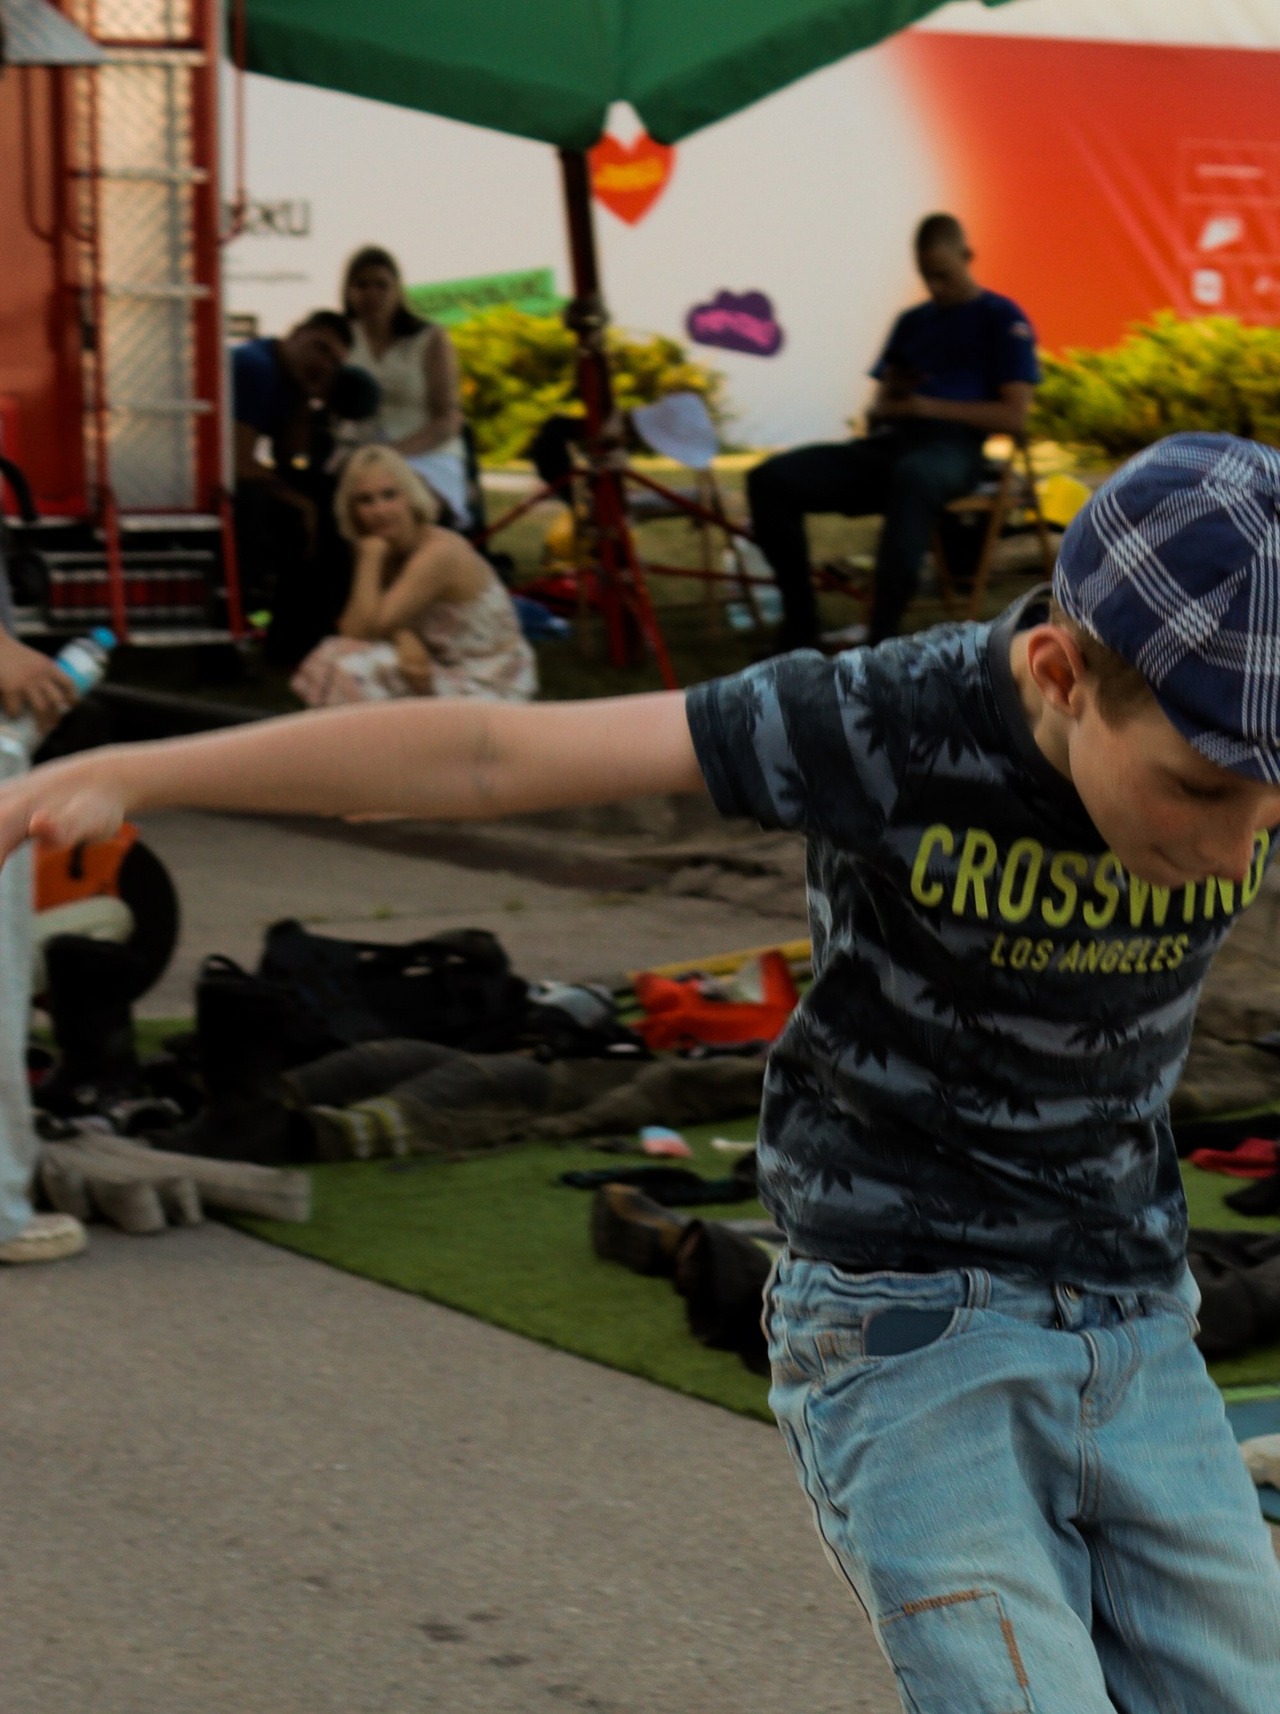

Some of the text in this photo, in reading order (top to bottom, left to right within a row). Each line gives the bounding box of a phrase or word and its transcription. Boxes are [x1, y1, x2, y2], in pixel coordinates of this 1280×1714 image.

[909, 823, 1269, 930] CROSSWIND
[990, 932, 1189, 975] LOS ANGELES
